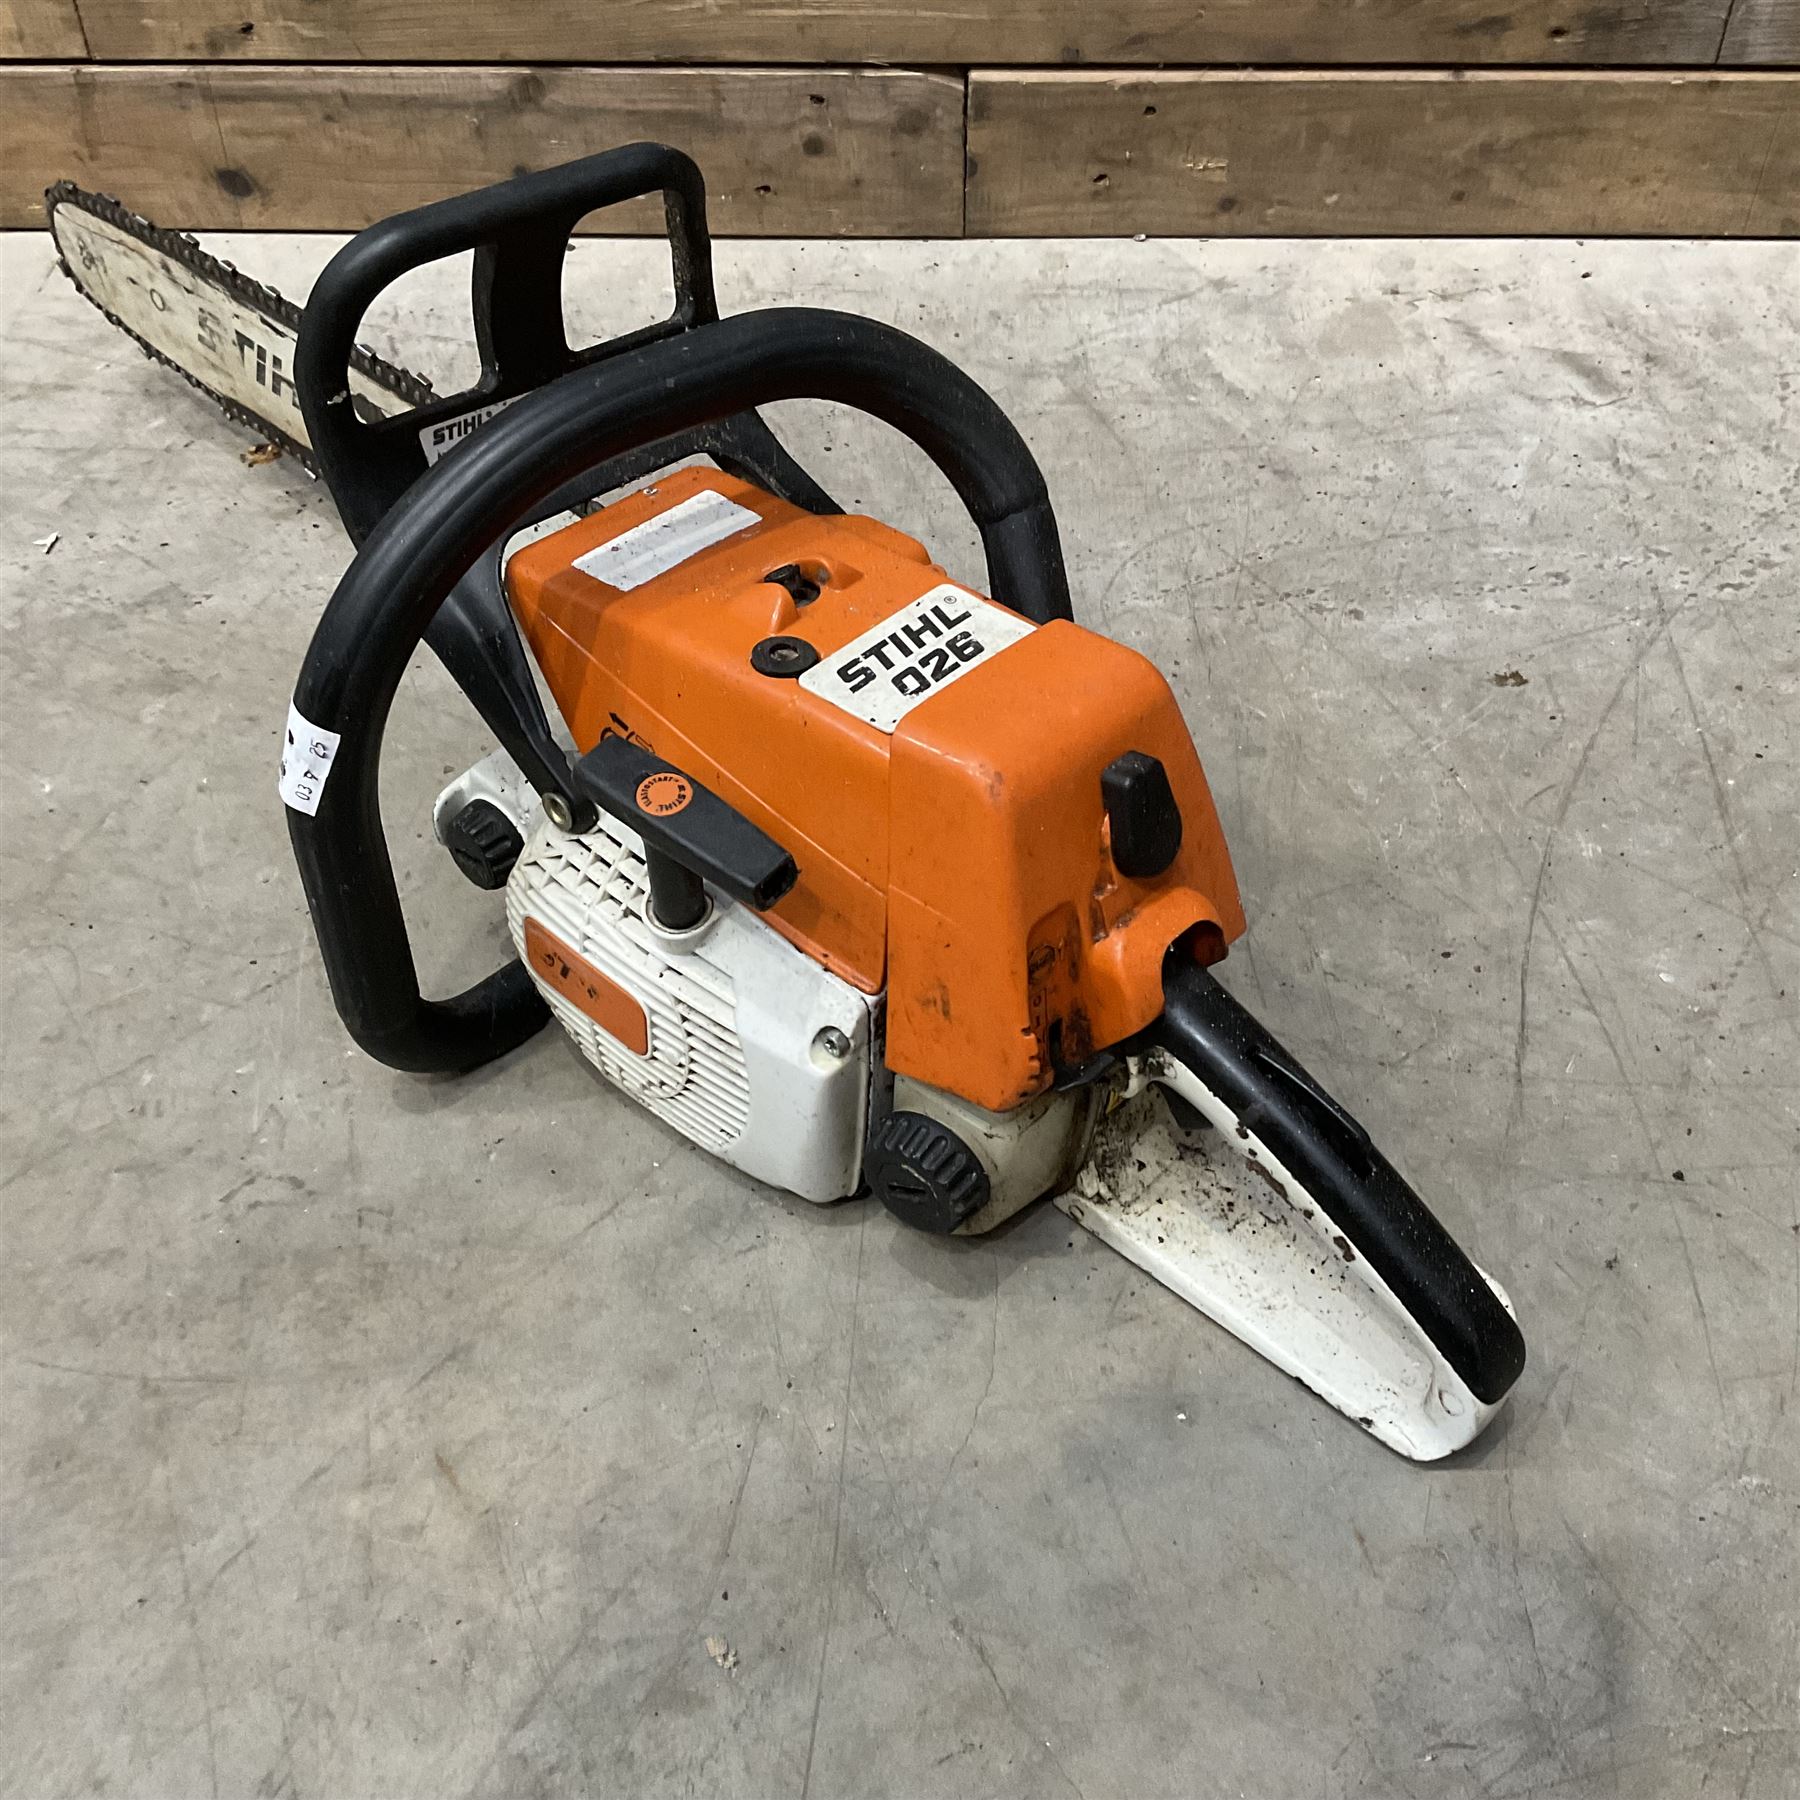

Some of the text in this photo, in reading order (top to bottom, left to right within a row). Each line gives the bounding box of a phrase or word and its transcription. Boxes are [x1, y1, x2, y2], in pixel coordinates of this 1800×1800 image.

[198, 307, 301, 410] STIH
[836, 605, 972, 694] STIHL
[891, 631, 985, 697] 026
